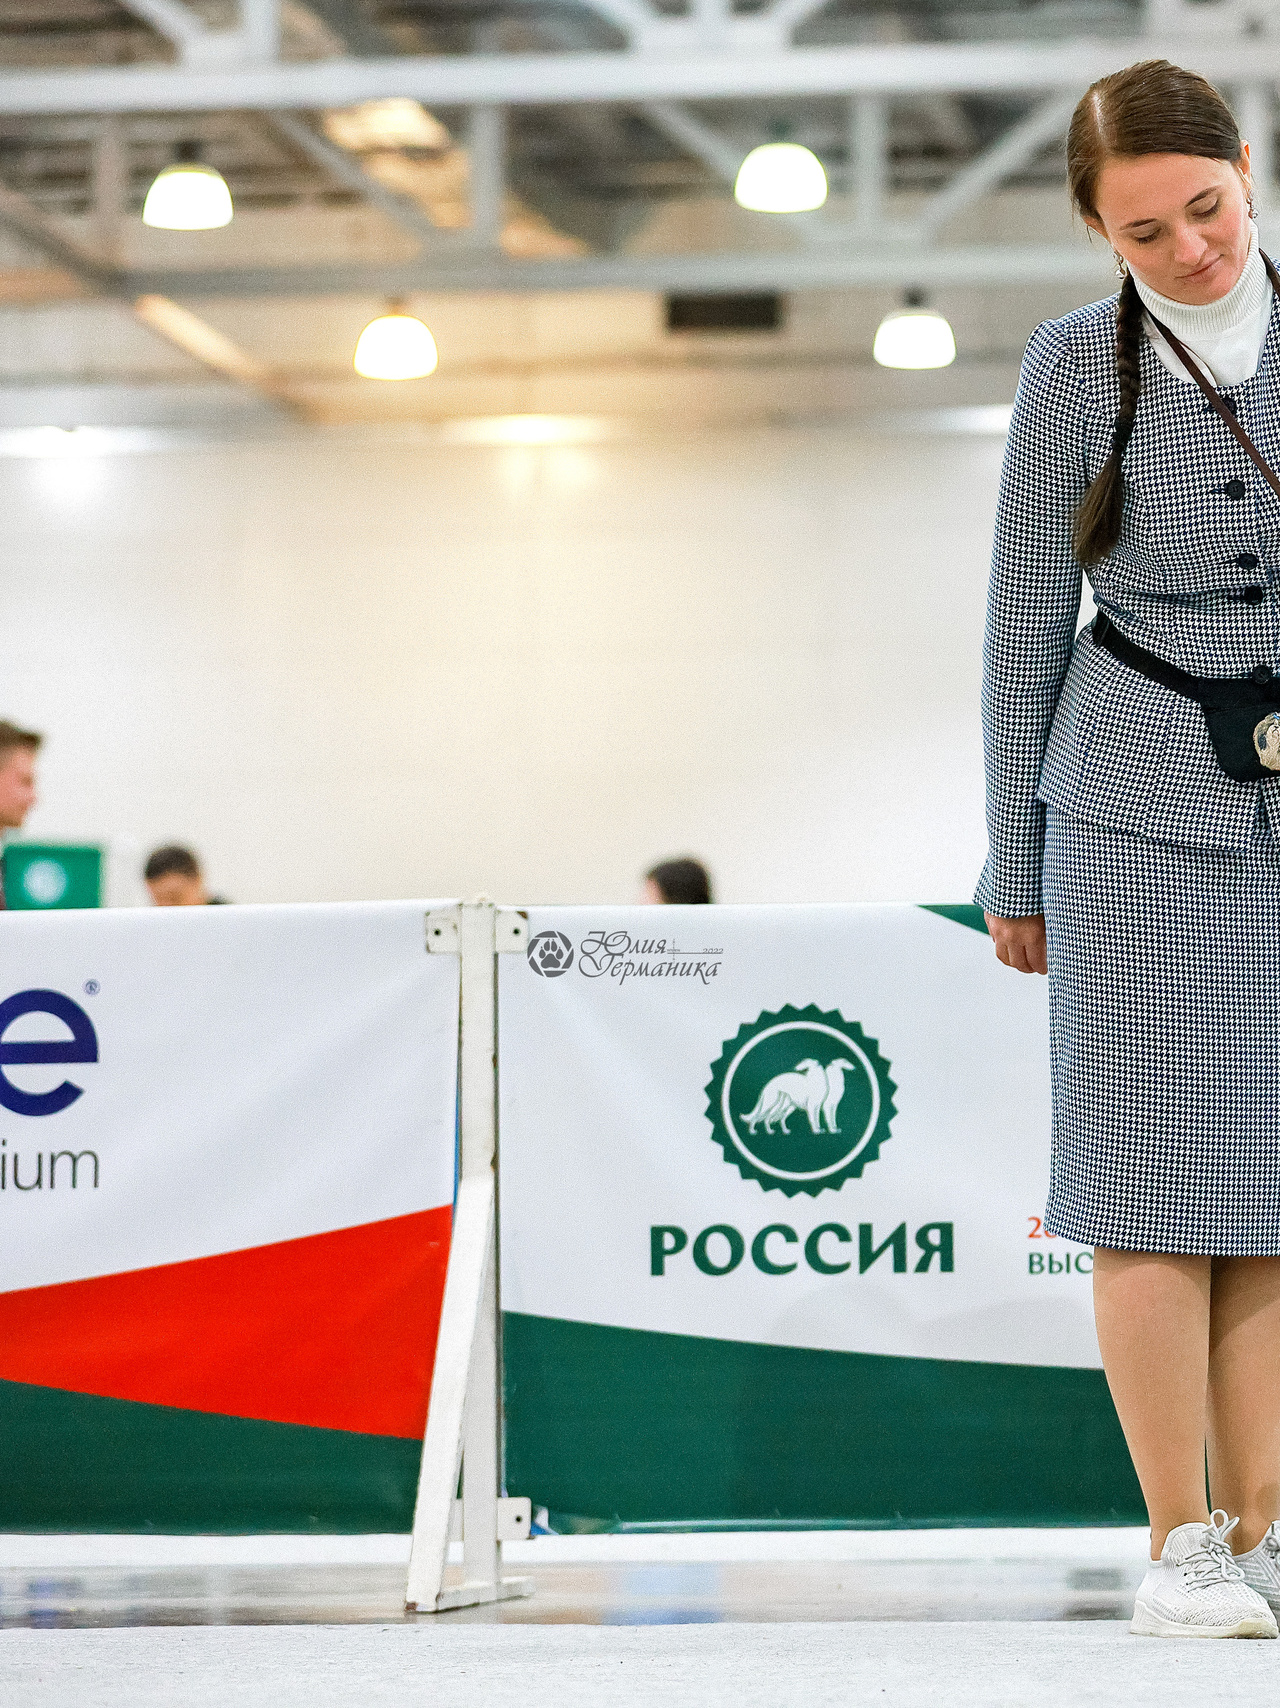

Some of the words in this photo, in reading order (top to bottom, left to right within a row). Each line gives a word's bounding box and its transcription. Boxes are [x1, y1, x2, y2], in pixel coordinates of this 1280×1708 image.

[1, 1138, 99, 1191] ium
[650, 1221, 955, 1277] РОССИЯ
[1027, 1216, 1057, 1239] 2
